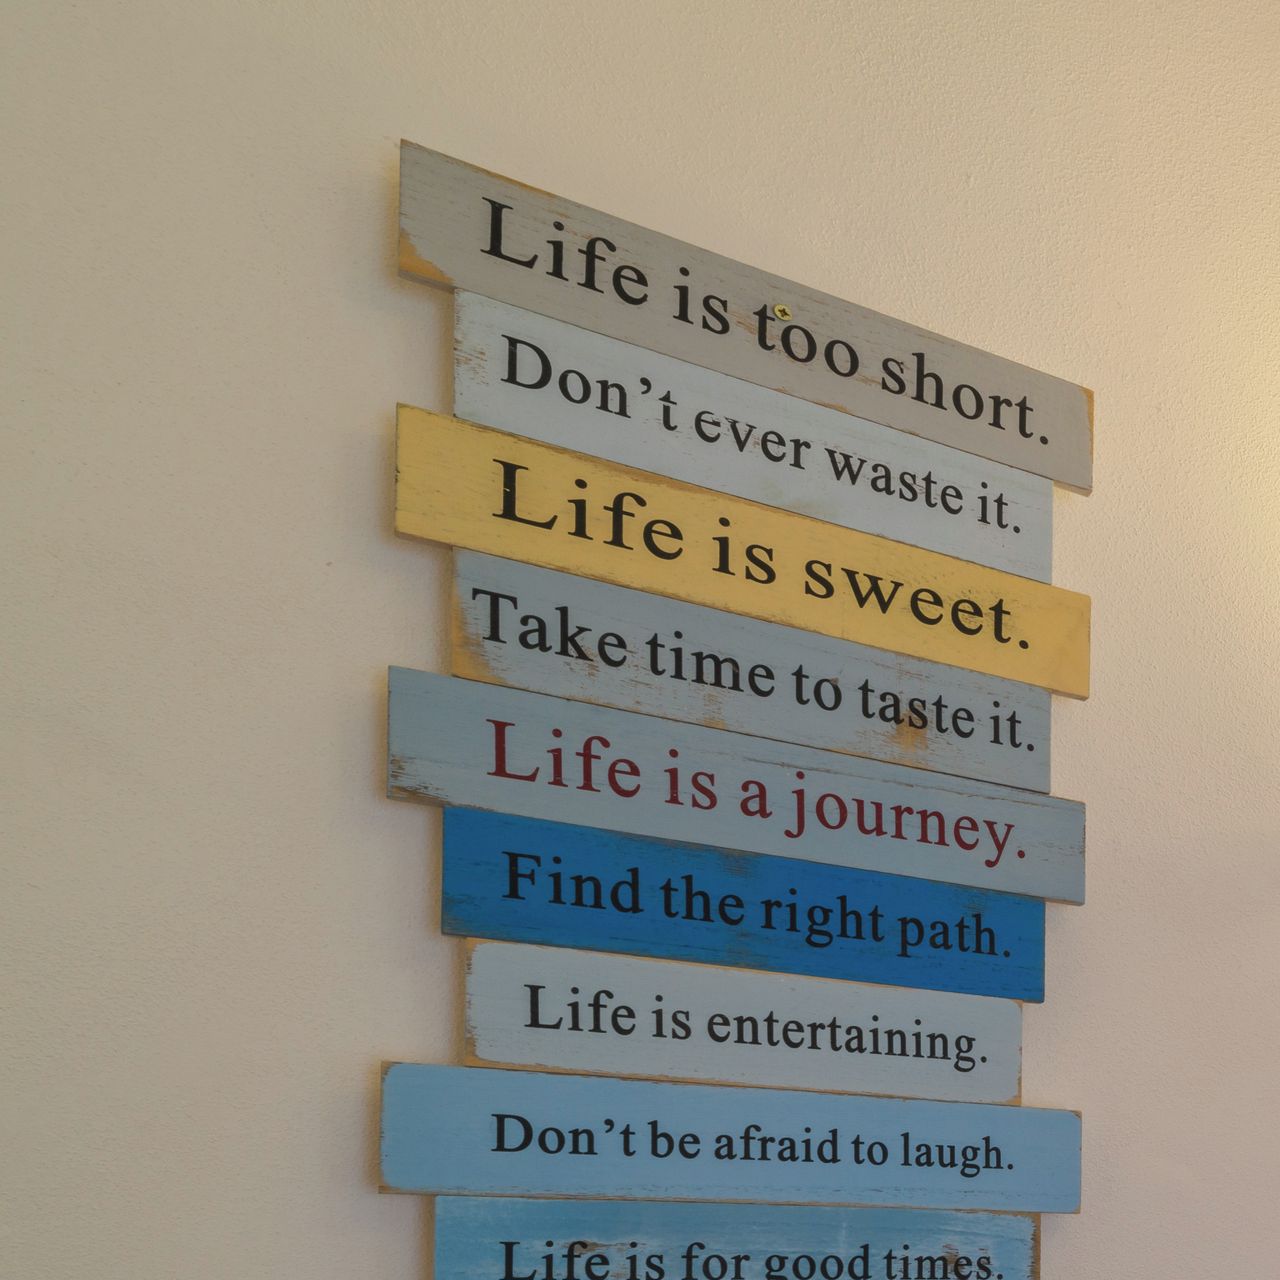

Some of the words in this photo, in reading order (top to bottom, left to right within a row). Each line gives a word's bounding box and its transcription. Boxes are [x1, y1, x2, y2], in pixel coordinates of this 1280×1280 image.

[480, 196, 650, 306] Life
[672, 266, 731, 335] is
[753, 305, 860, 377] too
[881, 352, 1050, 445] short.
[500, 335, 678, 431] Don't
[693, 411, 812, 470] ever
[824, 447, 965, 515] waste
[976, 482, 1022, 534] it.
[491, 459, 684, 560] Life
[711, 518, 778, 584] is
[803, 558, 1030, 649] sweet.
[470, 588, 628, 667] Take
[645, 631, 777, 697] time
[791, 664, 843, 711] to
[857, 679, 976, 738] taste
[988, 701, 1036, 751] it.
[485, 719, 642, 798] Life
[663, 749, 719, 810] is
[740, 778, 773, 818] a
[784, 771, 1027, 867] journey.
[501, 851, 642, 915] Find
[659, 874, 746, 927] the
[760, 890, 885, 947] right
[897, 912, 1013, 958] path.
[523, 984, 637, 1036] Life
[651, 996, 693, 1040] is
[707, 1011, 988, 1072] entertaining.
[491, 1113, 637, 1157] Don't
[649, 1121, 702, 1159] be
[714, 1126, 840, 1164] afraid
[851, 1135, 890, 1166] to
[900, 1135, 1015, 1178] laugh.
[681, 1242, 751, 1280] for
[882, 1246, 1004, 1280] times.
